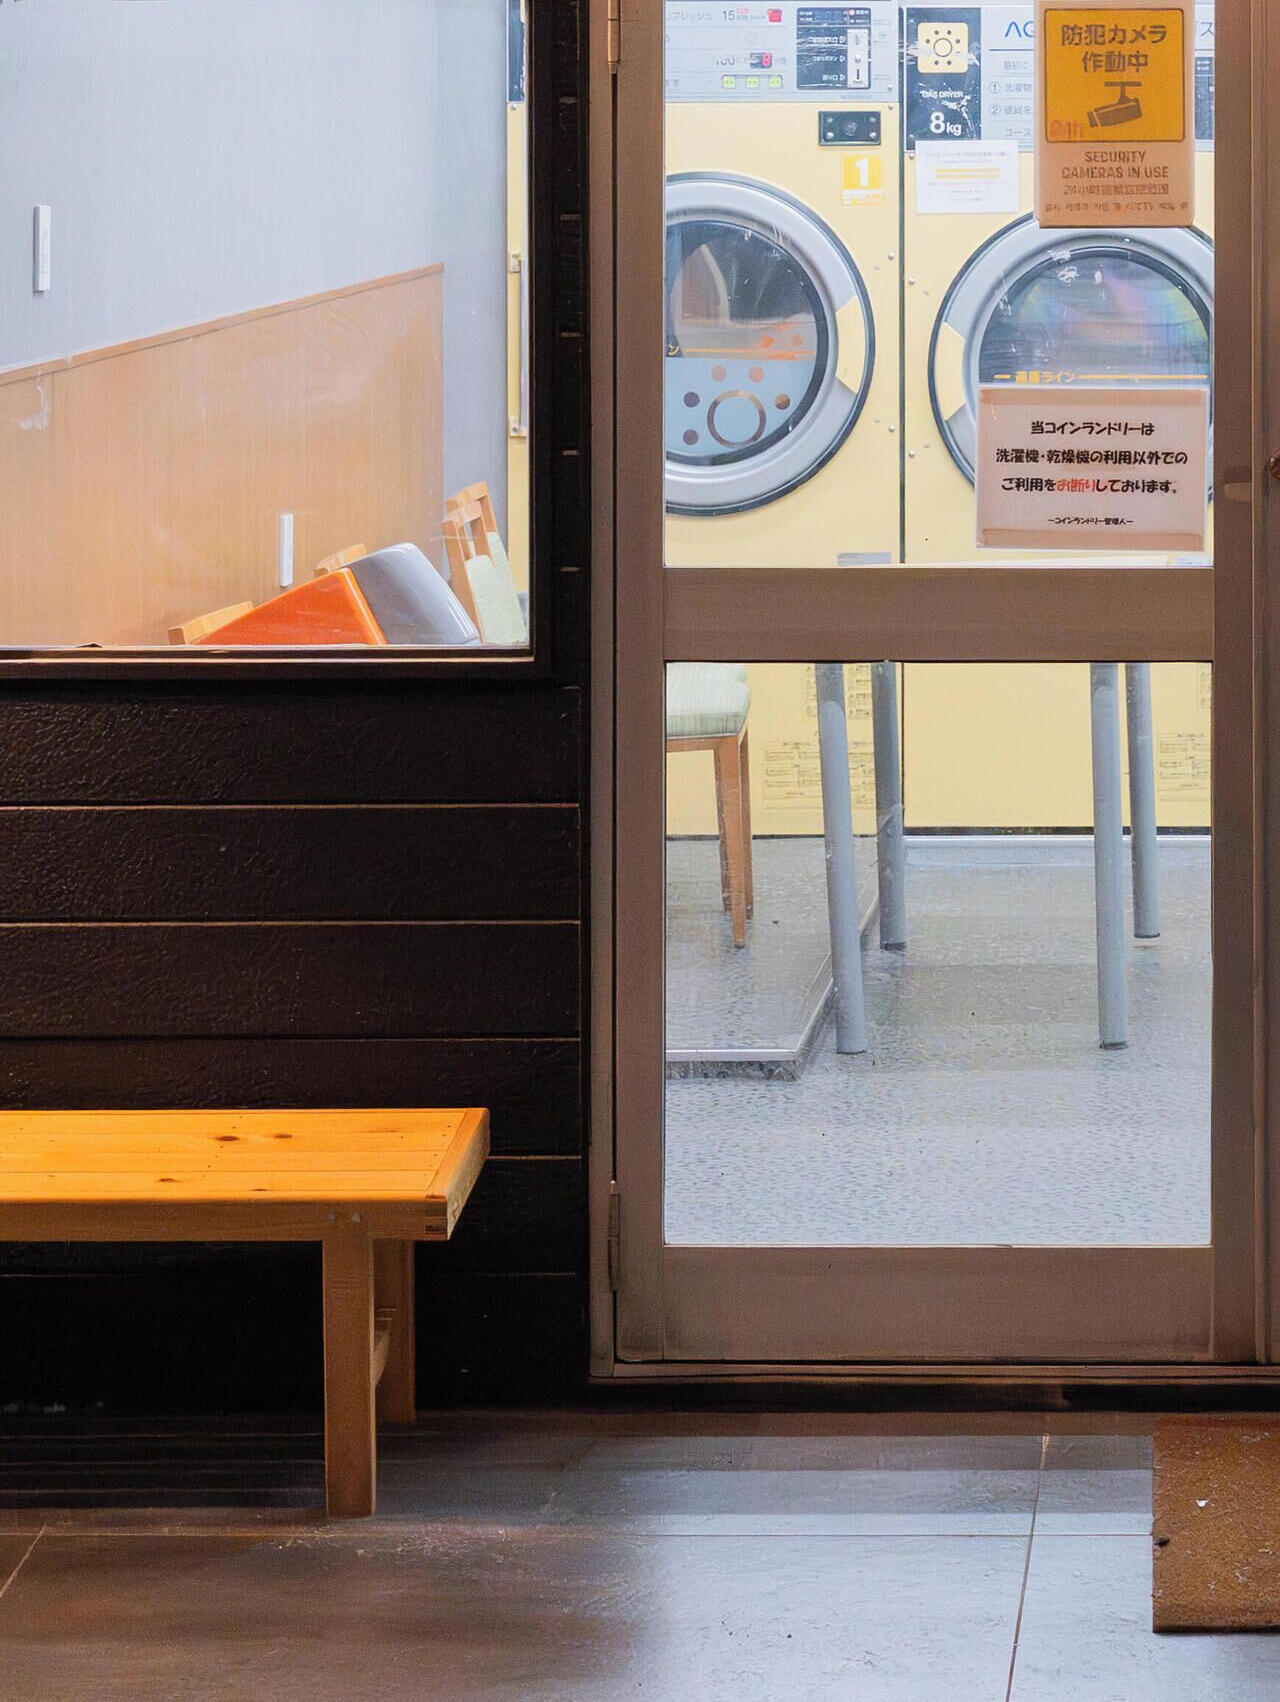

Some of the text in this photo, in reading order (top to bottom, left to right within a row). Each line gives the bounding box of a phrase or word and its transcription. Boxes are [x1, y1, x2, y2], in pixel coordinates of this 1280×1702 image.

[1061, 24, 1168, 47] 防犯カメラ
[1082, 50, 1149, 74] 作動中
[929, 111, 962, 135] 8kg
[1085, 150, 1146, 163] SECURITY
[855, 157, 870, 186] 1
[1062, 166, 1169, 179] CAMERAS IN USE
[1031, 420, 1155, 435] 当コインランドリーは
[996, 448, 1188, 465] 洗濯機・乾燥機の利用以外での
[1001, 477, 1177, 494] ご利用をお断りしております。
